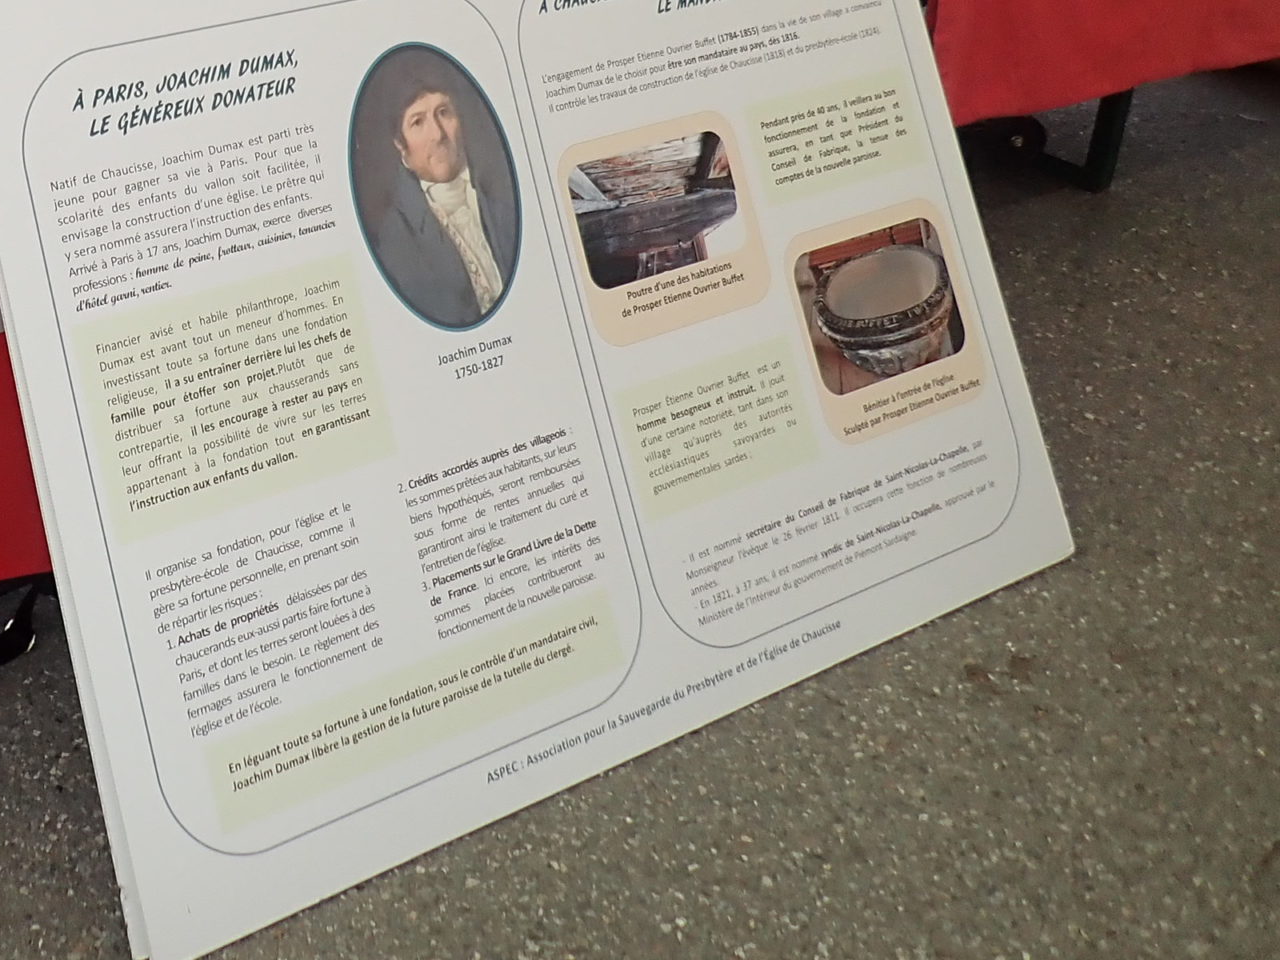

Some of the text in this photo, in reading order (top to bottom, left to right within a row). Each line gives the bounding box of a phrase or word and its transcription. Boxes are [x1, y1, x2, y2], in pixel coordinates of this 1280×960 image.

[72, 48, 298, 112] À PARIS, JOACHIM DUMAX,
[89, 76, 296, 137] LE GÉNÉREUX DONATEUR
[49, 123, 315, 193] Natif de Chaucisse, Joachim Dumax est parti très
[53, 139, 318, 213] jeune pour gagner sa vie à Paris. Pour que la
[57, 153, 321, 227] scolarité des enfants du vallon soit facilitée, il
[621, 273, 745, 318] de Prosper Etienne Ouvrier Buffet
[626, 262, 733, 301] Poutre d'une des habitations
[438, 336, 513, 366] Joachim Dumax
[454, 354, 504, 380] 1750-1827
[636, 384, 757, 433] homme besogneux et instruit.
[129, 451, 298, 512] l'instruction aux enfants du vallon.
[397, 483, 407, 494] 2.
[408, 472, 439, 490] Crédits
[441, 458, 480, 479] accordés
[480, 448, 510, 465] auprès
[512, 442, 528, 454] des
[529, 427, 567, 448] villageois
[228, 615, 598, 774] En léguant toute sa fortune à une fondation, sous le contrôle d'un mandataire civil,
[487, 760, 519, 784] ASPEC
[526, 735, 582, 768] Association
[583, 724, 606, 744] pour
[606, 719, 618, 731] la
[617, 695, 671, 726] Sauvegarde
[672, 689, 686, 702] du
[685, 668, 733, 696] Presbytère
[735, 662, 746, 674] et
[746, 657, 758, 669] de
[758, 643, 788, 664] l'Église
[789, 638, 800, 650] de
[801, 620, 841, 644] Chaucisse
